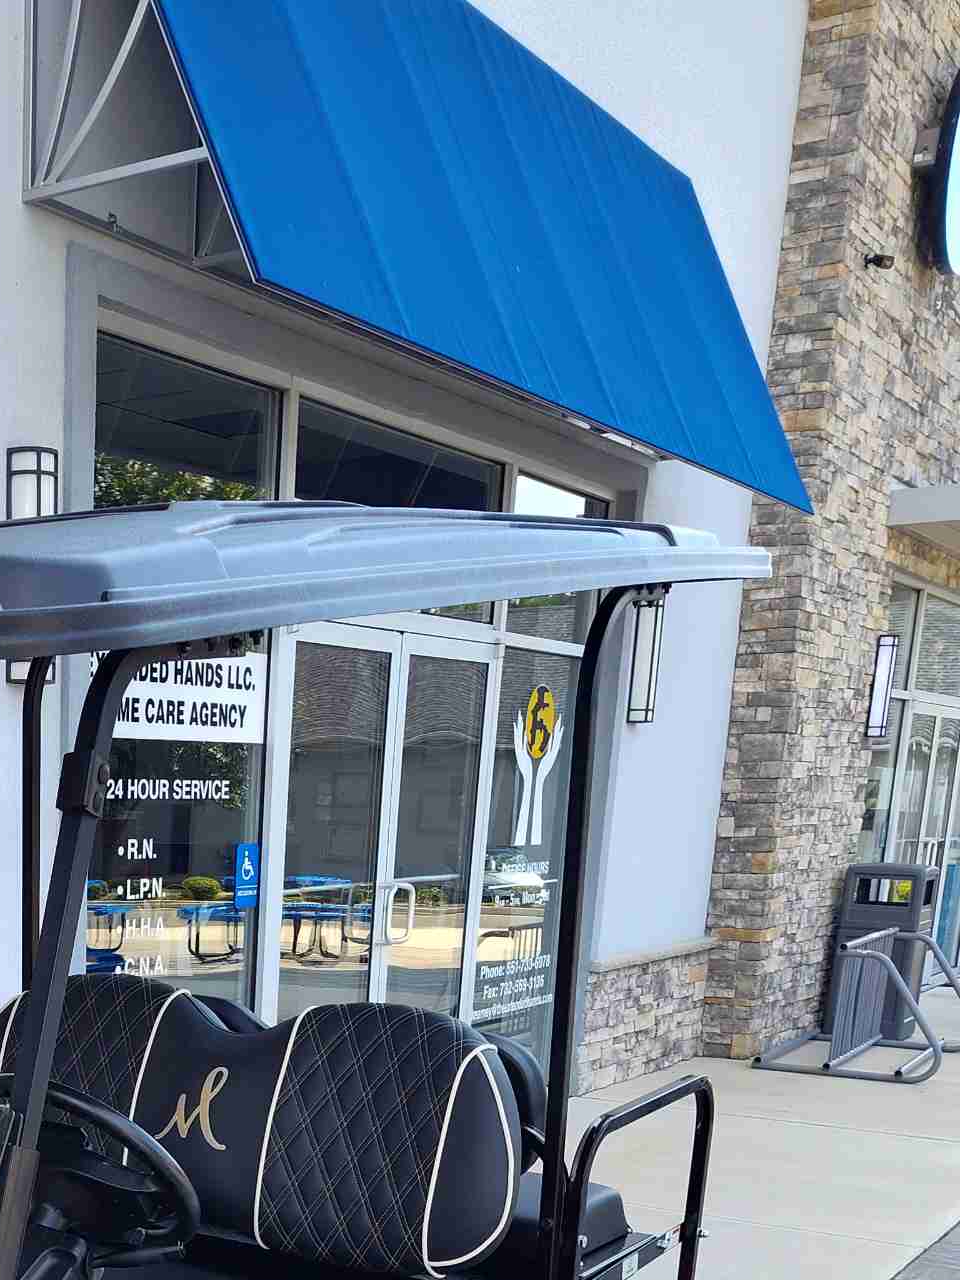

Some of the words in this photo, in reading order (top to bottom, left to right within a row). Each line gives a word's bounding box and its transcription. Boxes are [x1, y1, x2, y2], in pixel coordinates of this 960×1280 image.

[174, 660, 223, 689] HANDS
[227, 664, 256, 692] LLC.
[117, 697, 140, 723] ME
[145, 698, 185, 725] CARE
[189, 701, 247, 729] AGENCY
[106, 778, 124, 800] 24
[127, 778, 170, 800] HOUR
[173, 779, 230, 800] SERVICE
[480, 965, 505, 980] Phone:
[483, 985, 499, 1000] Fax:
